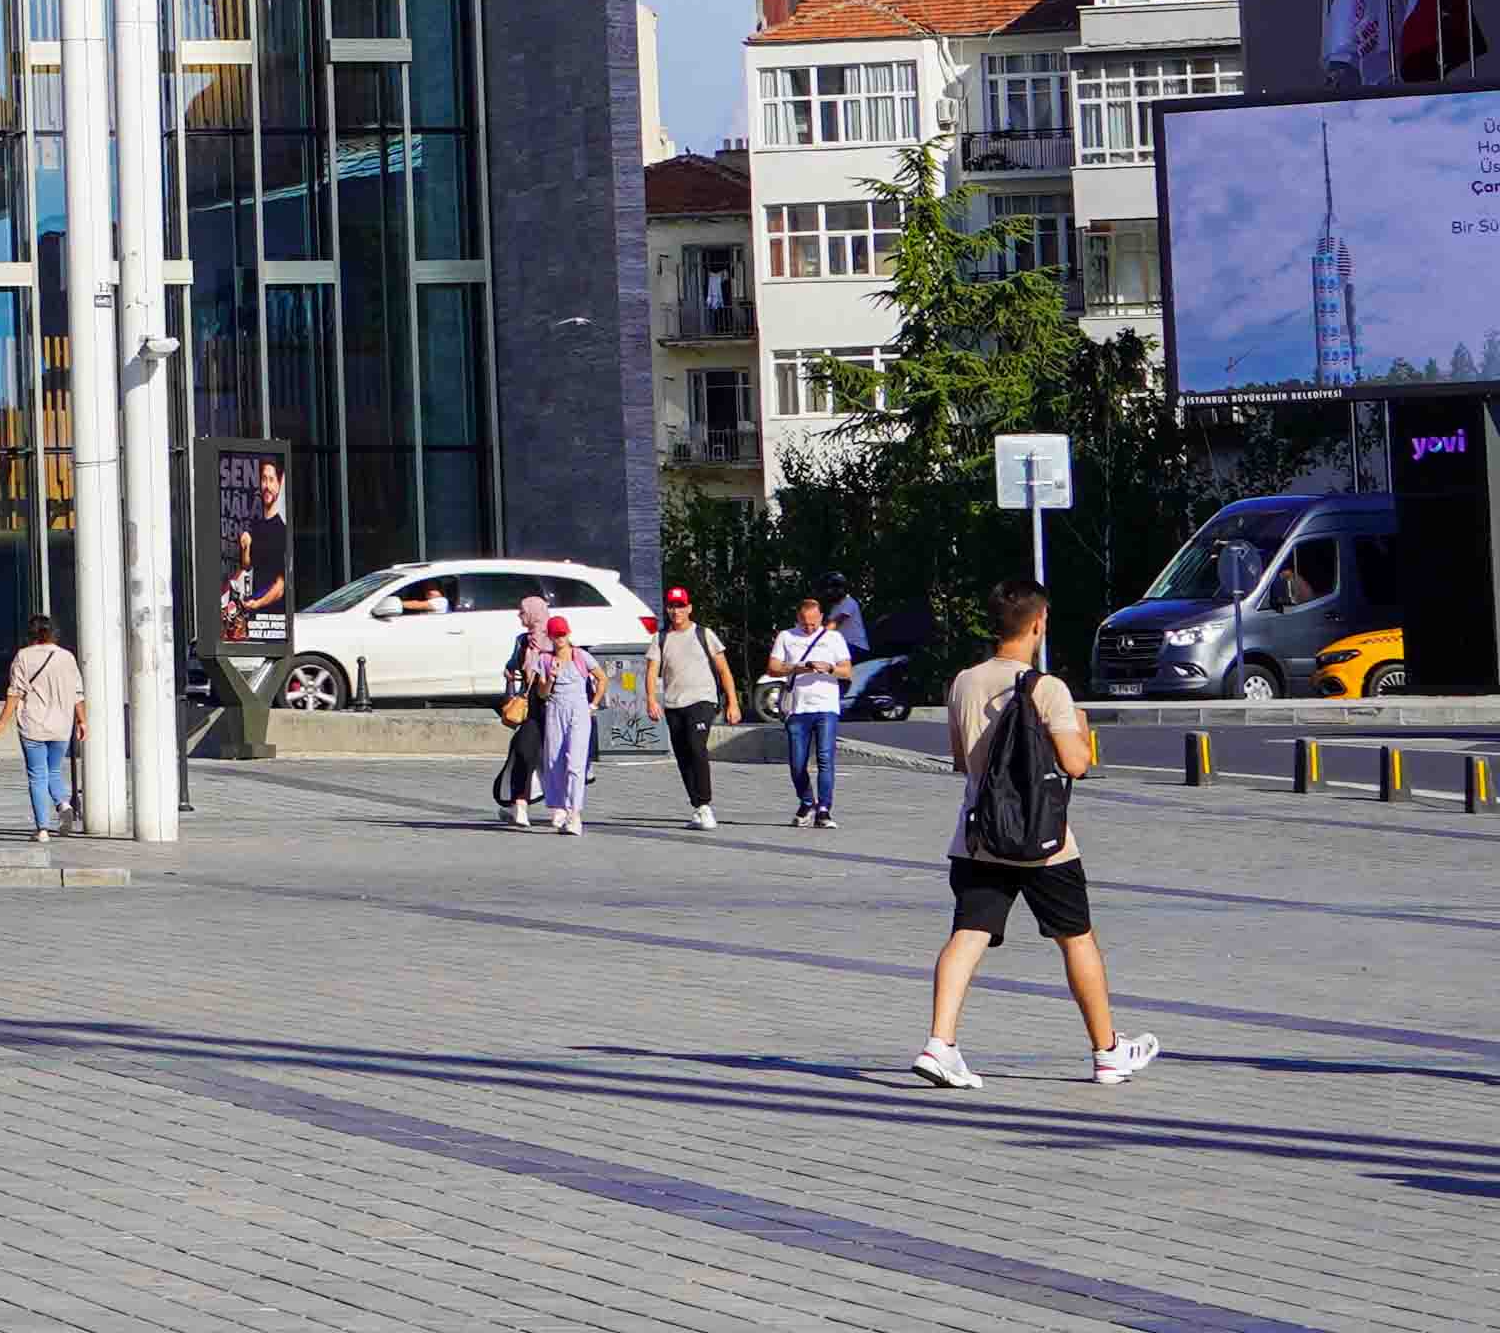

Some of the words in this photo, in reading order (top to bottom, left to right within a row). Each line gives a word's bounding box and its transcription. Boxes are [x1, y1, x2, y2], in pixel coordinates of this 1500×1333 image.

[1451, 219, 1474, 234] Bir
[1411, 428, 1466, 461] yovi
[220, 458, 260, 488] SEN
